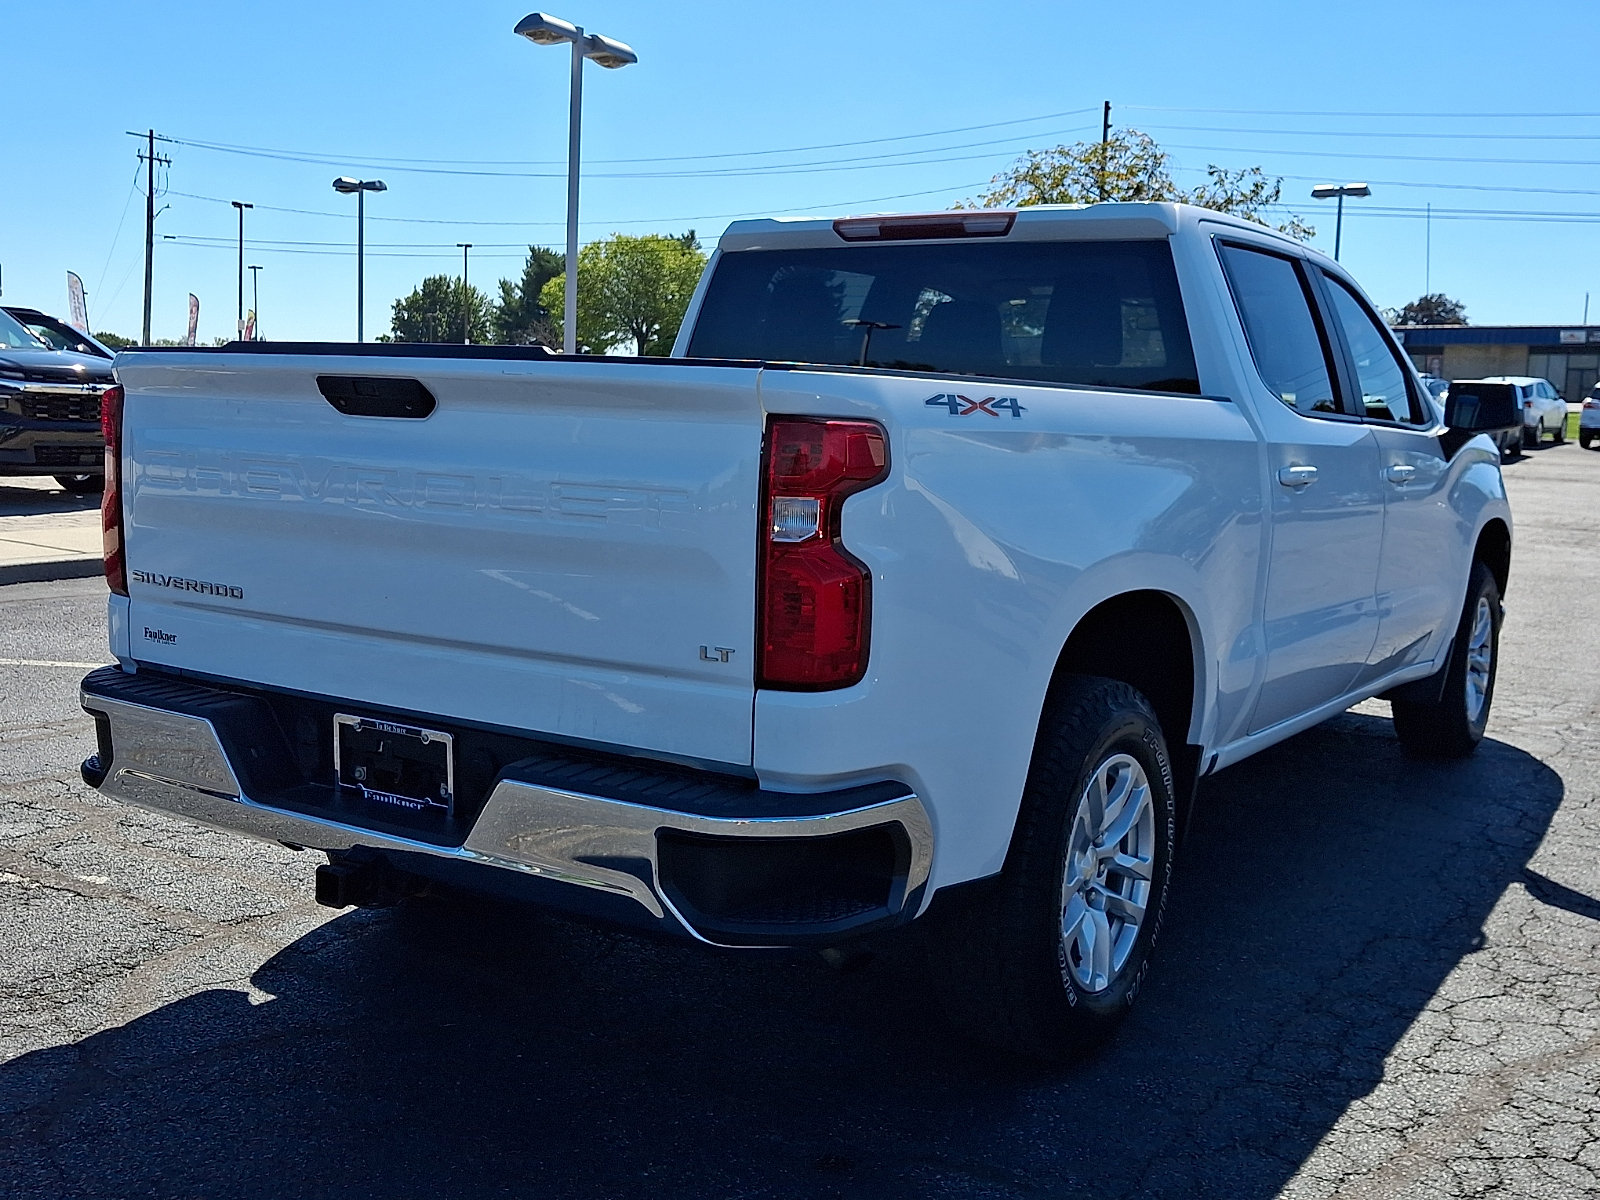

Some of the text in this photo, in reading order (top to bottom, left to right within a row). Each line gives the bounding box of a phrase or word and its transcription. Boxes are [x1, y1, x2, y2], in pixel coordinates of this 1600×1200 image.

[134, 450, 690, 529] CHEVROLET
[132, 569, 243, 600] SILVERADO
[144, 627, 177, 642] Faulkner
[700, 645, 736, 663] LT
[393, 725, 407, 735] Sure
[364, 791, 424, 810] Faulkner
